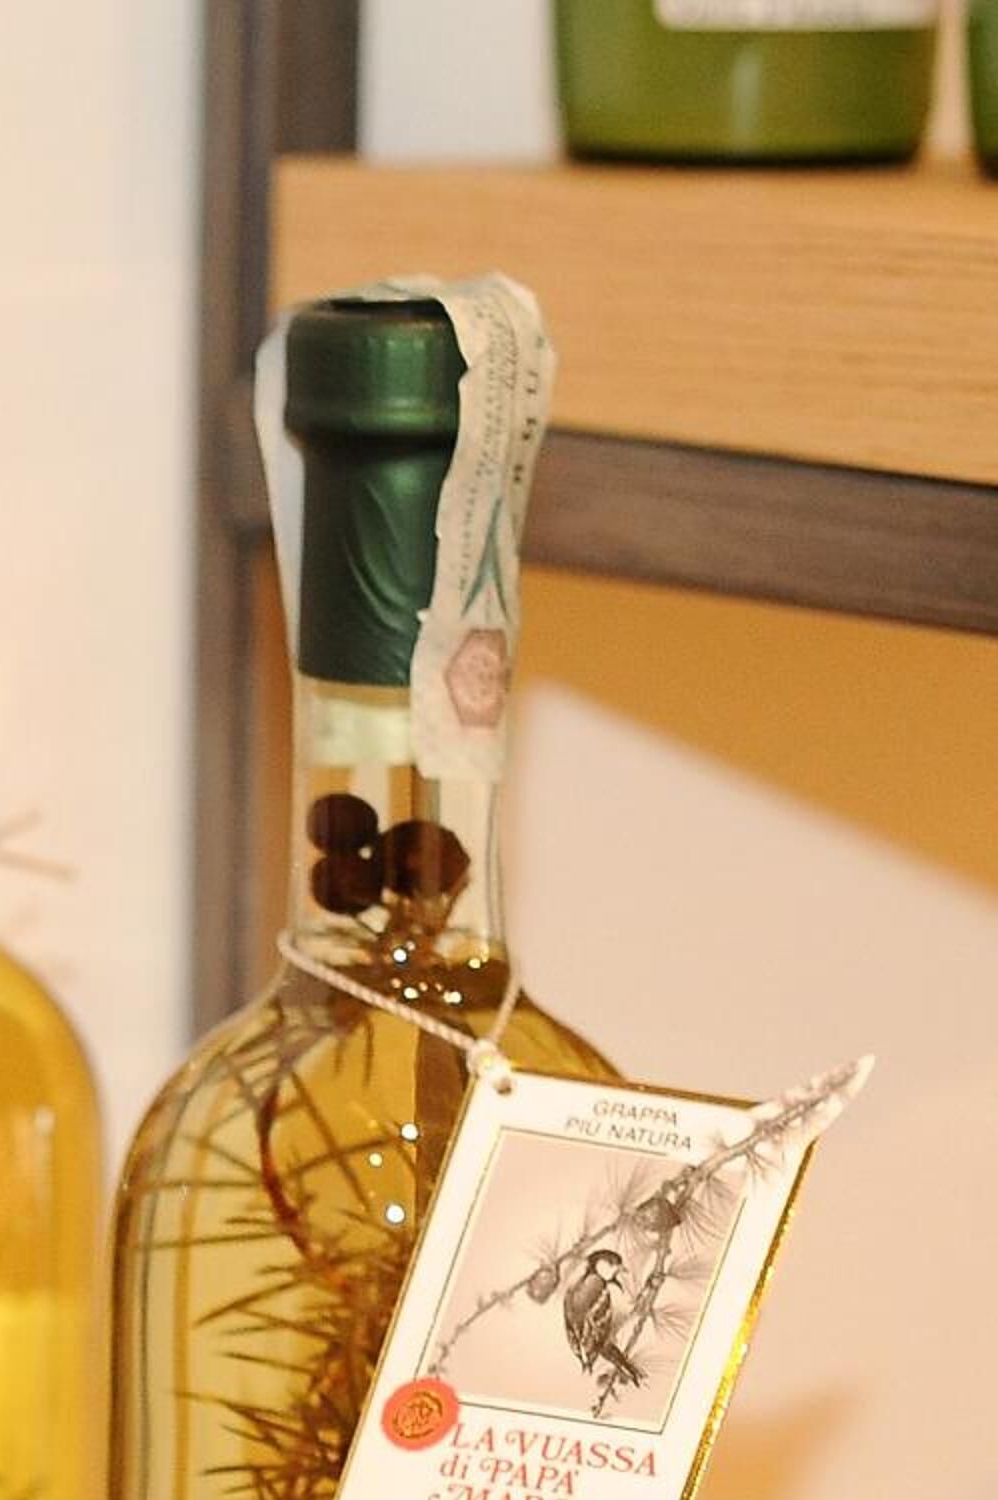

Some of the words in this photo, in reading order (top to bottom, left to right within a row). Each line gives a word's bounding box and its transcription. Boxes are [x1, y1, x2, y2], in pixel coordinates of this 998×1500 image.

[593, 1101, 678, 1127] GRAPPA
[608, 1123, 692, 1152] NATURA
[450, 1422, 496, 1453] LA
[505, 1429, 657, 1477] VUASSA
[439, 1454, 470, 1480] di
